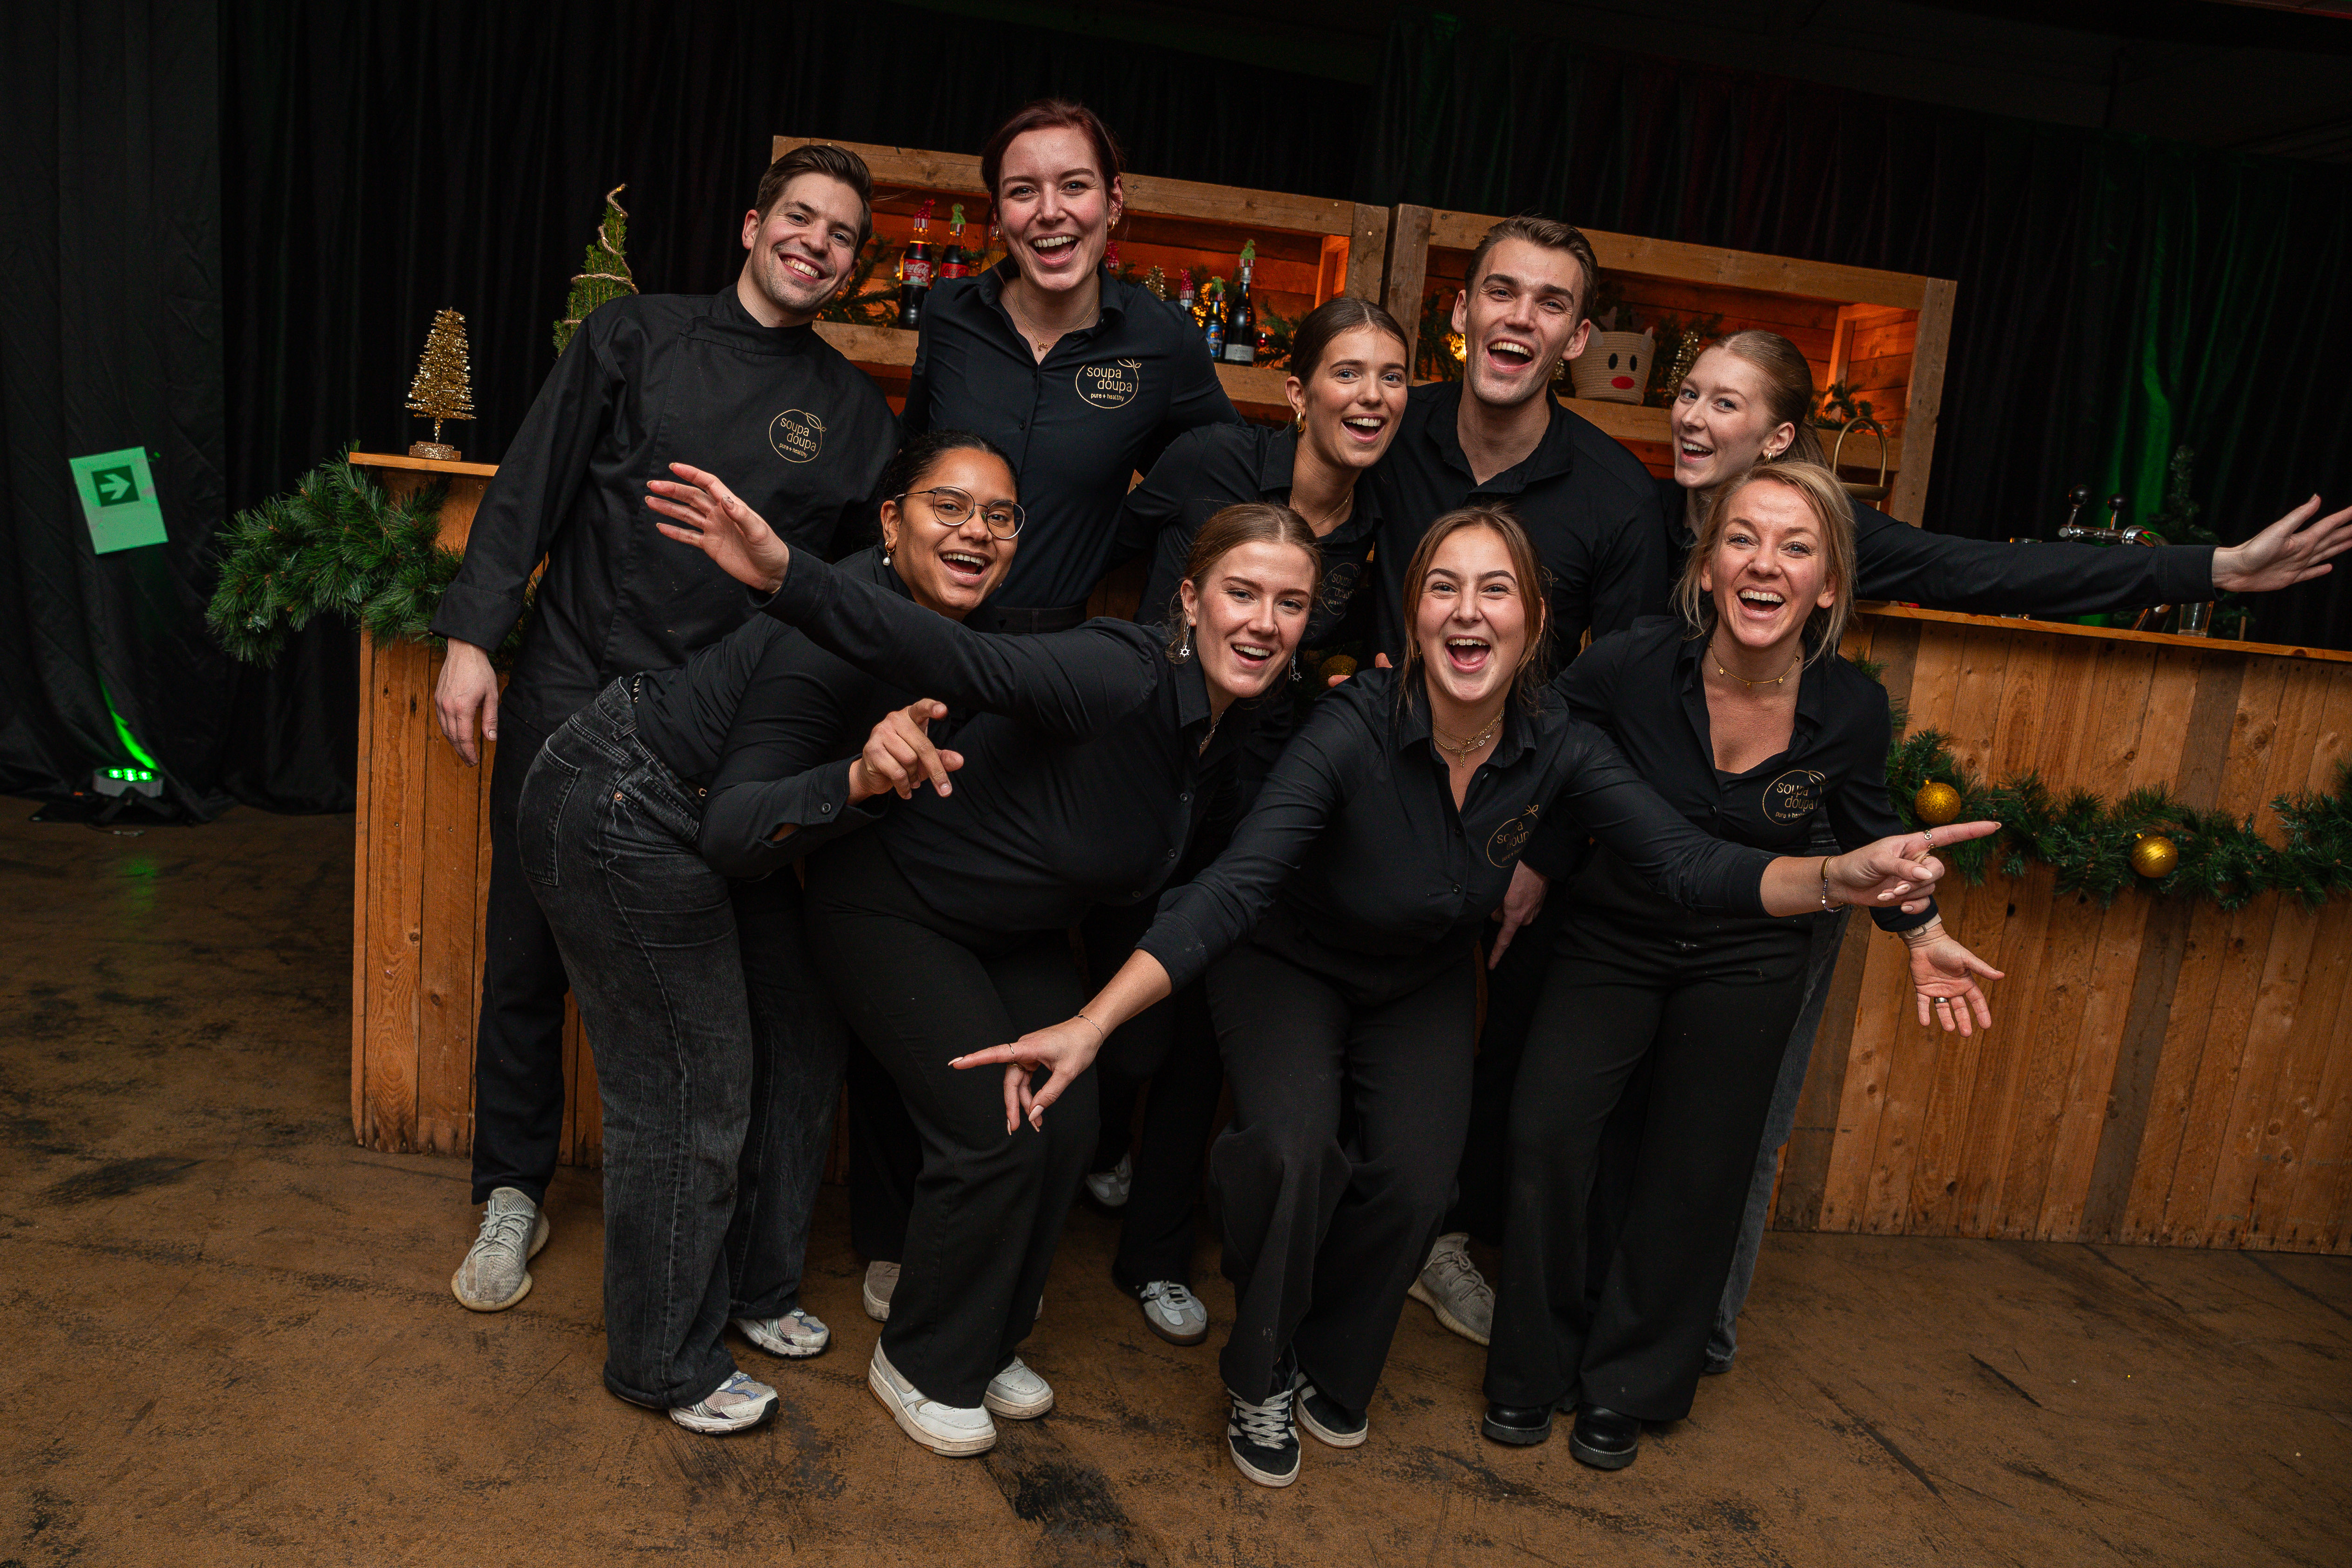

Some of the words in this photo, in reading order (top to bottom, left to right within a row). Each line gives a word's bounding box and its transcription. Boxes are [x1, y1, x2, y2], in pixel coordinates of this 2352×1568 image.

[1086, 367, 1121, 380] soupa
[1097, 378, 1132, 394] doupa
[1107, 393, 1125, 402] healthy
[780, 418, 809, 437] soupa
[786, 432, 816, 452] doupa
[792, 448, 808, 459] healthy
[1785, 795, 1813, 812] doupa
